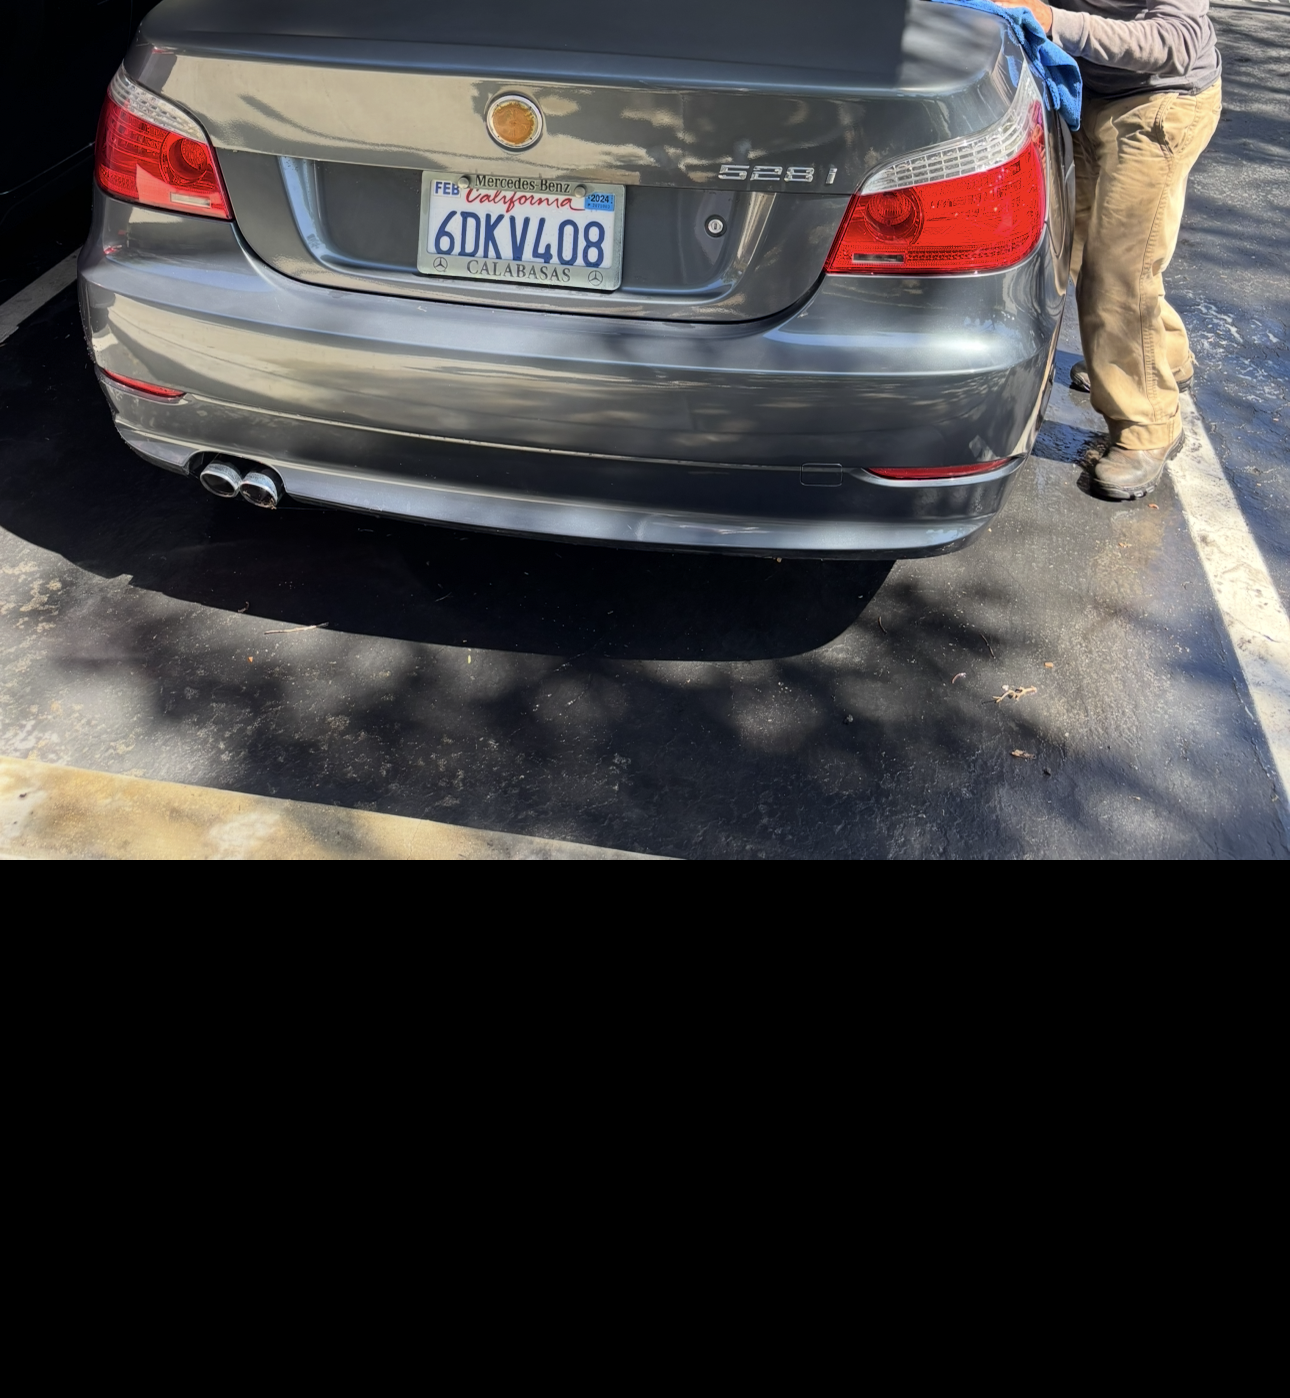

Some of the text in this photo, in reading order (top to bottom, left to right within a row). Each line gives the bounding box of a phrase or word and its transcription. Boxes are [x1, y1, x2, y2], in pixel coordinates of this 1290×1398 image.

[435, 181, 460, 196] FEB
[475, 175, 571, 194] Mercedes-Benz
[465, 187, 586, 213] California
[590, 193, 610, 204] 2024
[434, 210, 606, 269] 6DKV408
[467, 260, 571, 283] CALABASAS
